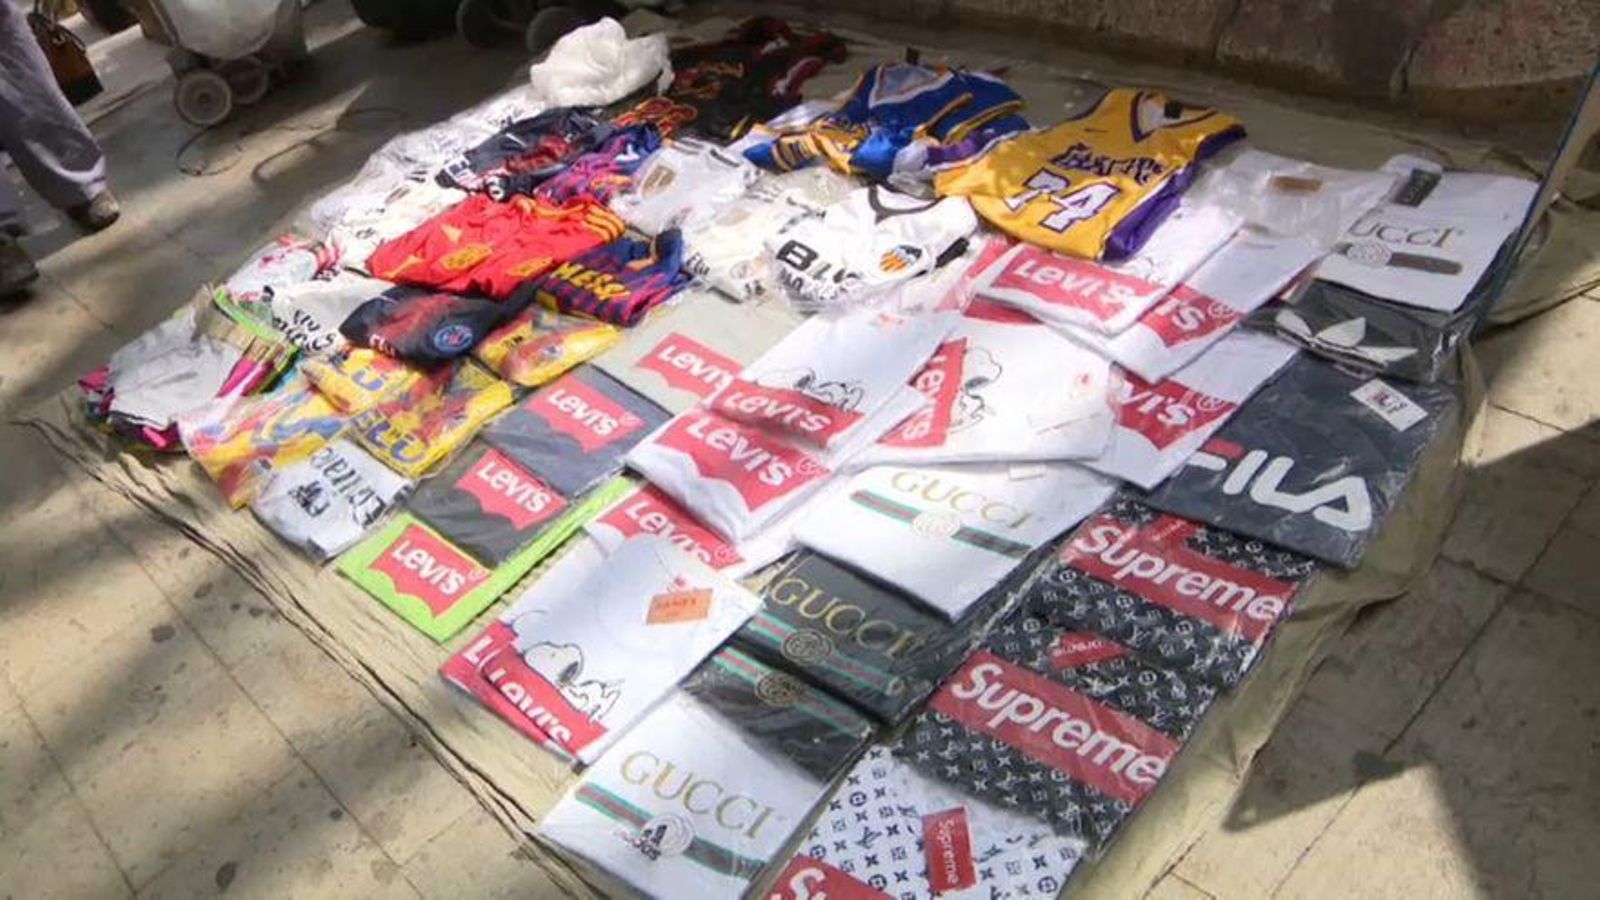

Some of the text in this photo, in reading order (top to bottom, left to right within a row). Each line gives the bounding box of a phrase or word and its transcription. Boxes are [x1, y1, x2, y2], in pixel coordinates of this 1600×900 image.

[1349, 209, 1456, 247] UCCI
[891, 471, 1033, 529] GUCCI
[1077, 525, 1284, 621] Supreme
[771, 578, 915, 659] GUCCI
[952, 663, 1166, 785] Supreme
[620, 750, 775, 839] GUCCI
